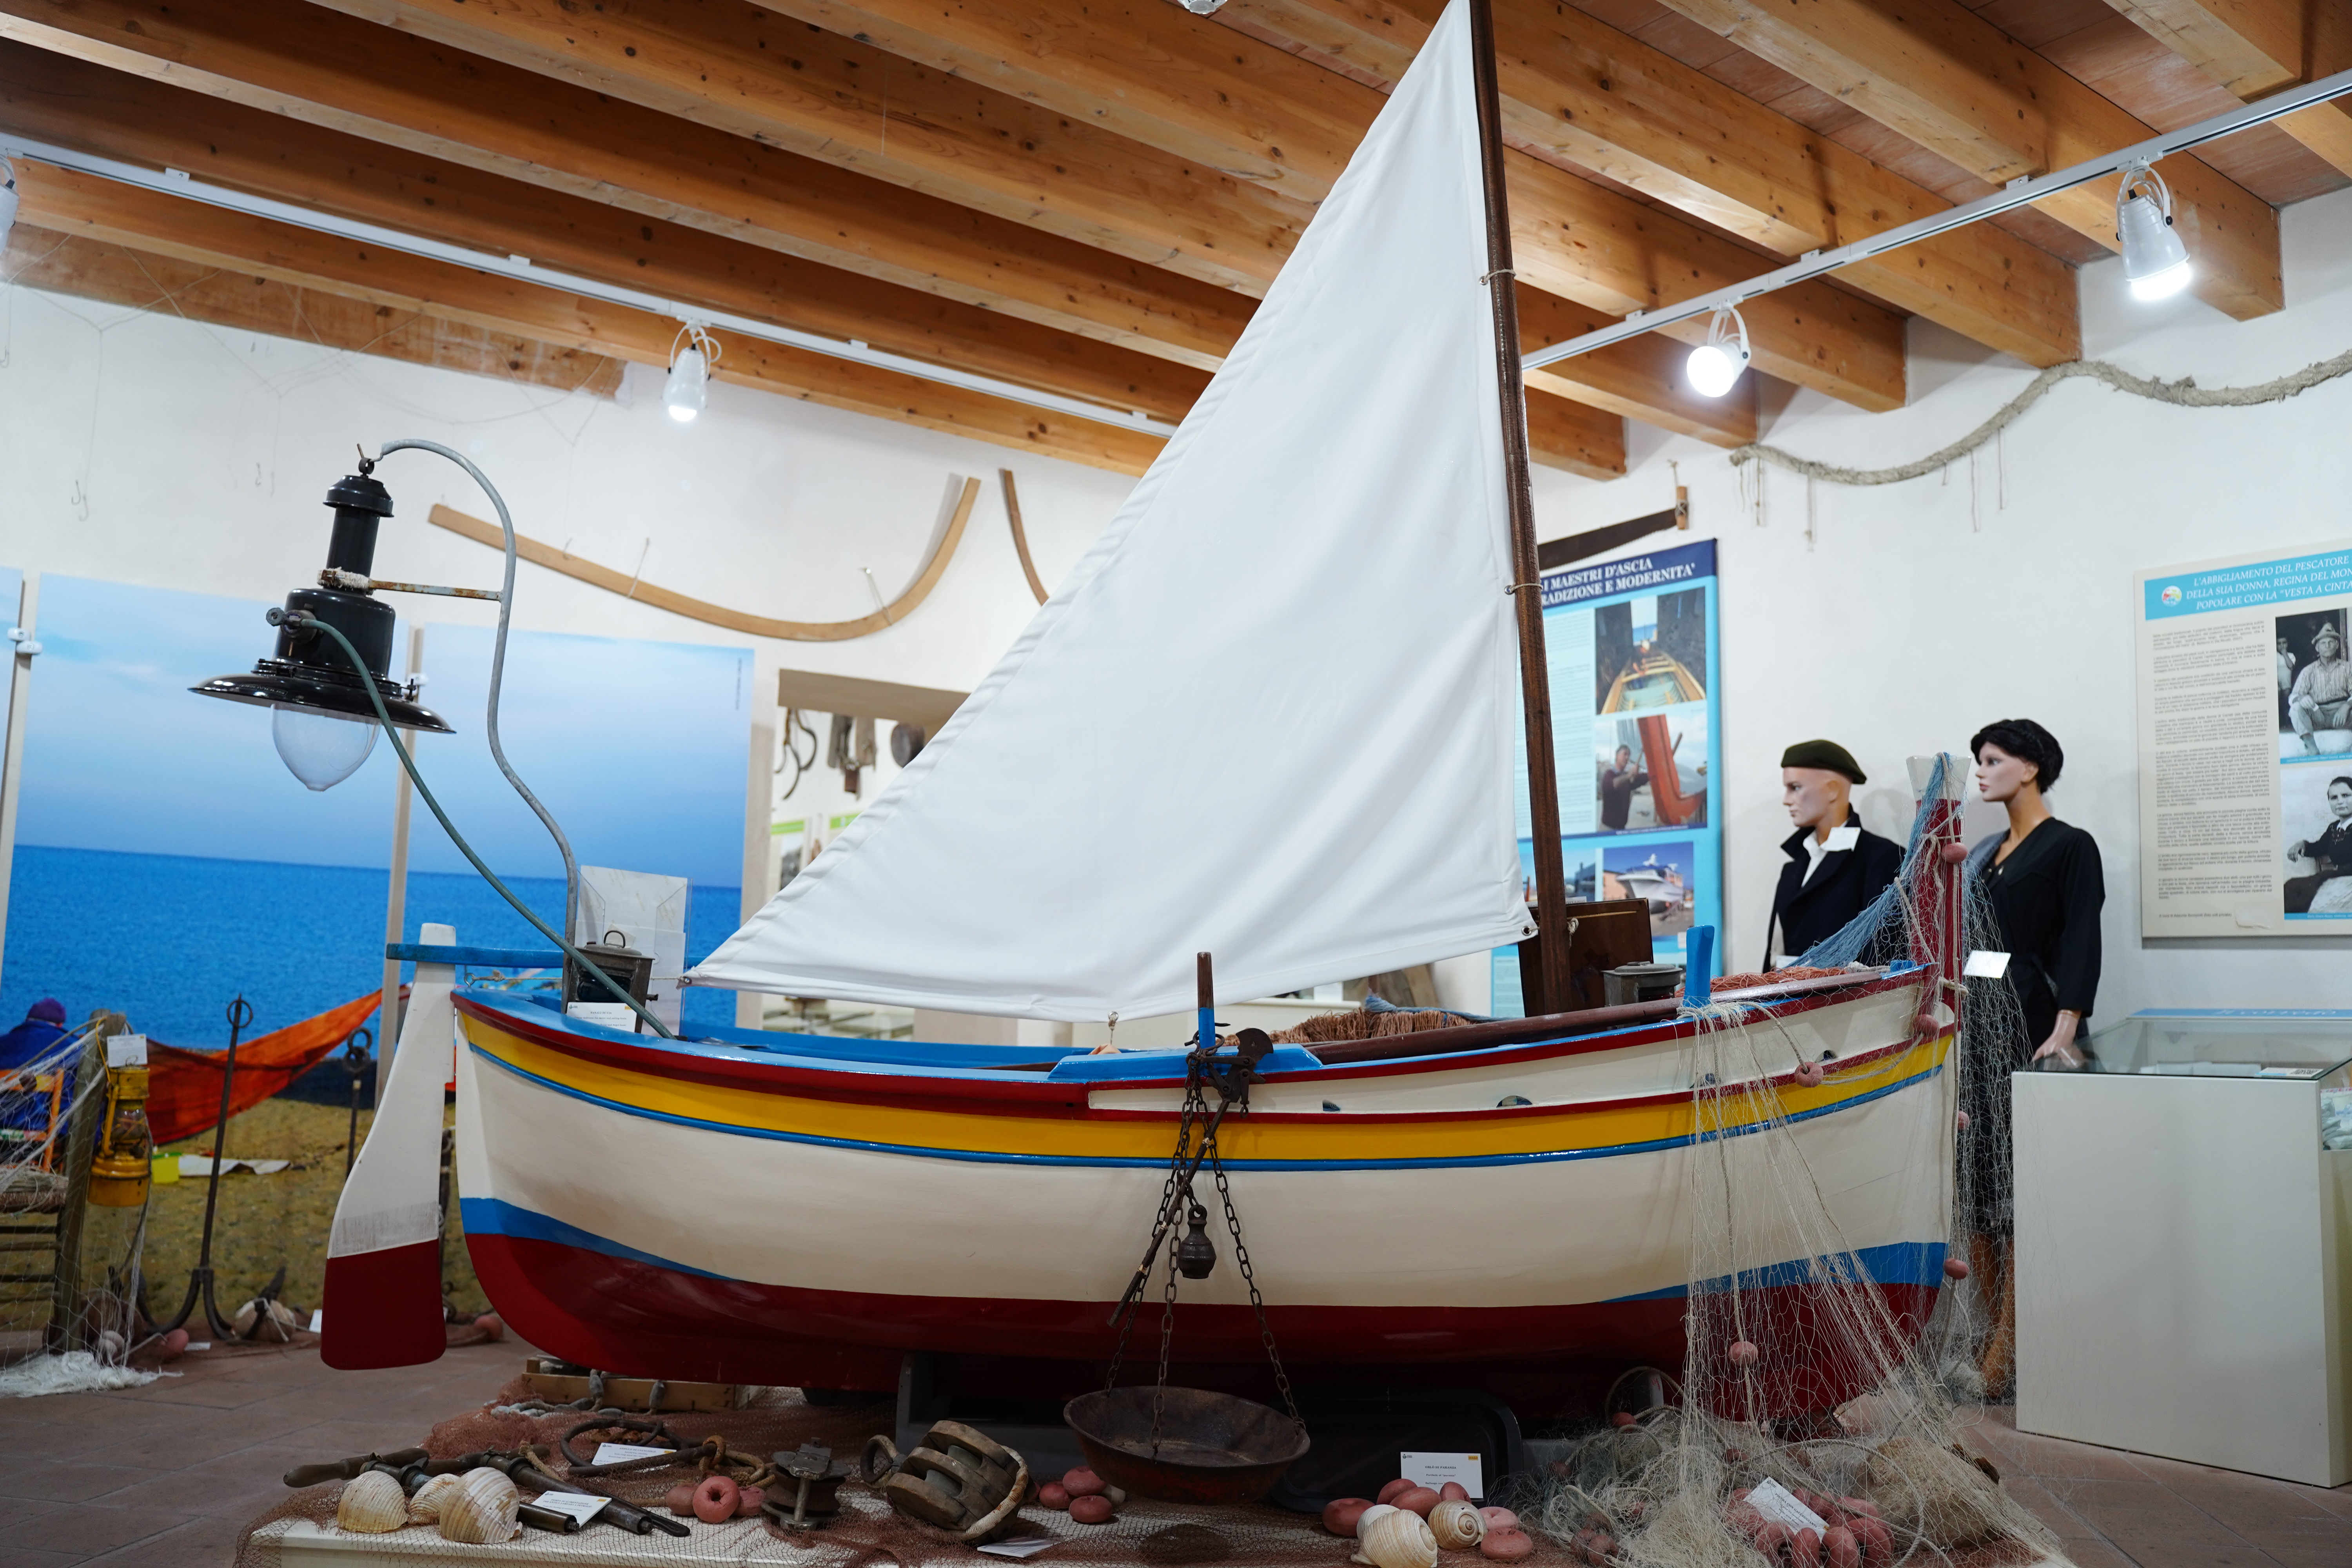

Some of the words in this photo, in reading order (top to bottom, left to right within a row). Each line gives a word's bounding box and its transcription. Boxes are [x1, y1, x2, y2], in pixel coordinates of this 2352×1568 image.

[1541, 582, 1603, 606] RADIZIONE
[1605, 579, 1614, 593] E
[1615, 562, 1696, 591] MODERNITA'
[1551, 568, 1602, 590] MAESTRI
[1604, 557, 1653, 579] D'ASCIA
[2186, 588, 2213, 600] DELLA
[2216, 585, 2233, 595] SUA
[2236, 580, 2271, 593] DONNA,
[2274, 574, 2308, 587] REGINA
[2310, 571, 2328, 582] DEL
[2194, 567, 2273, 586] L'ABBIGLIAMENTO
[2275, 564, 2293, 574] DEL
[2295, 555, 2349, 571] PESCATORE
[2196, 595, 2242, 610] POPOLARE
[2244, 592, 2264, 603] CON
[2266, 591, 2277, 600] LA
[2316, 584, 2322, 593] A
